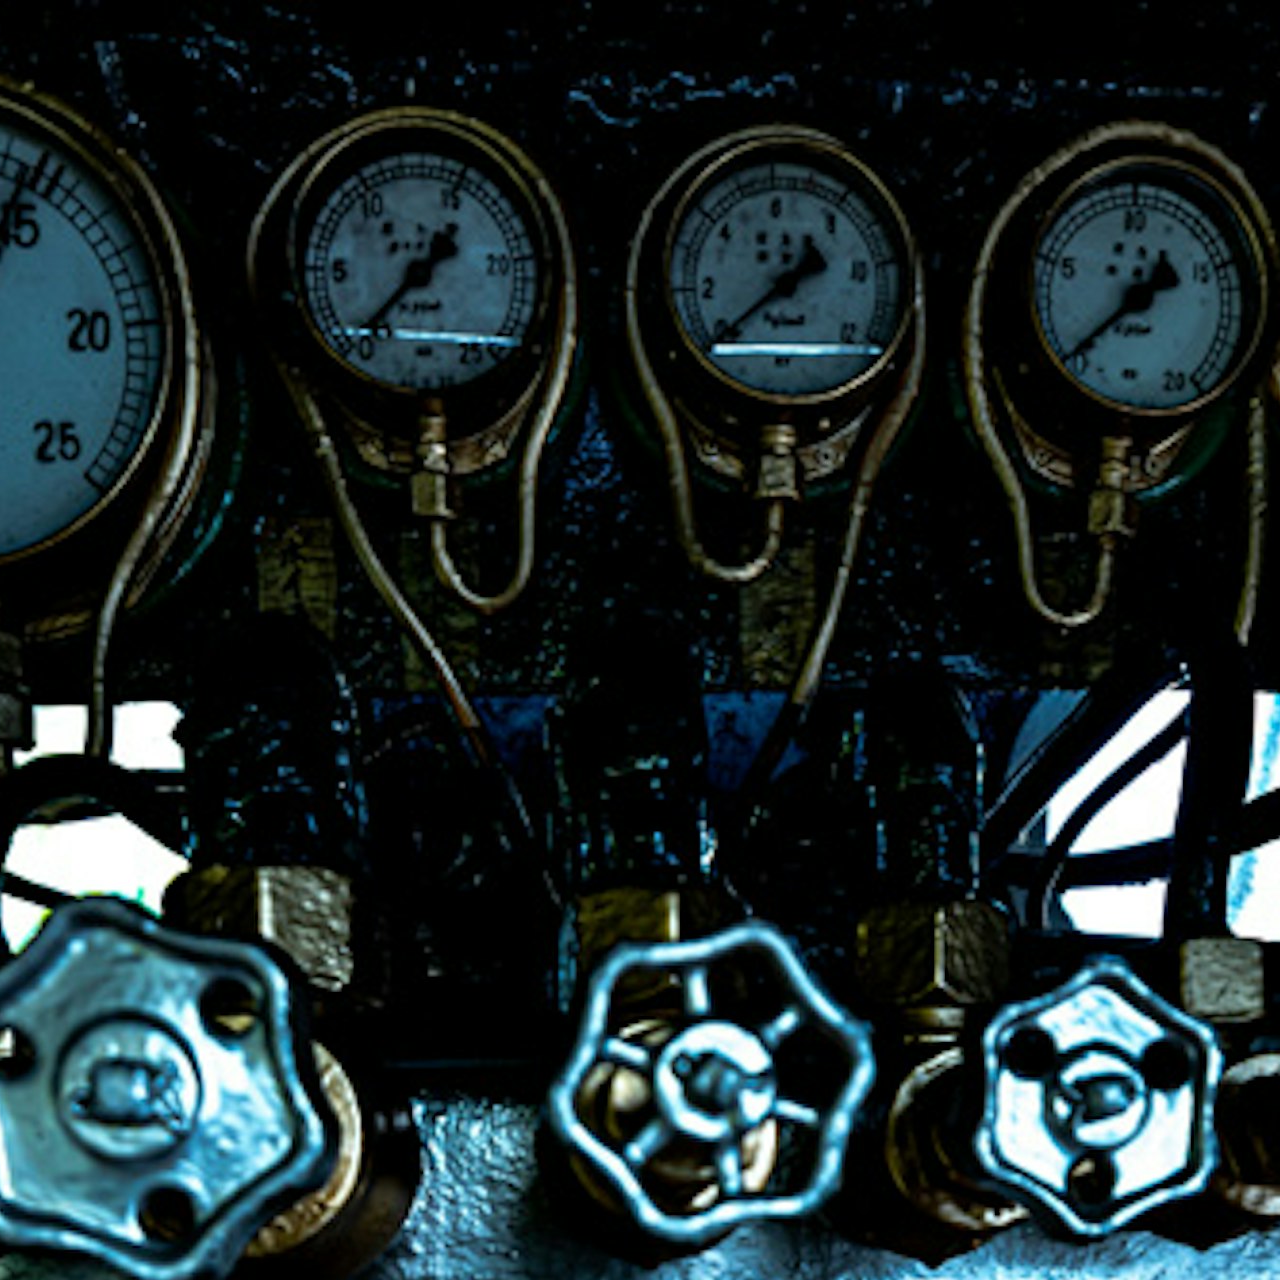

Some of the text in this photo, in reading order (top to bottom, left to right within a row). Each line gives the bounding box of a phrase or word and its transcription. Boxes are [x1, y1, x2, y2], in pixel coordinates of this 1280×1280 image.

[362, 193, 383, 219] 10
[721, 223, 730, 242] 4
[332, 258, 348, 282] 5
[485, 253, 509, 276] 20
[1062, 258, 1076, 279] 5
[702, 277, 714, 299] 2
[67, 308, 110, 353] 20
[1163, 371, 1185, 392] 20
[34, 422, 80, 463] 25
